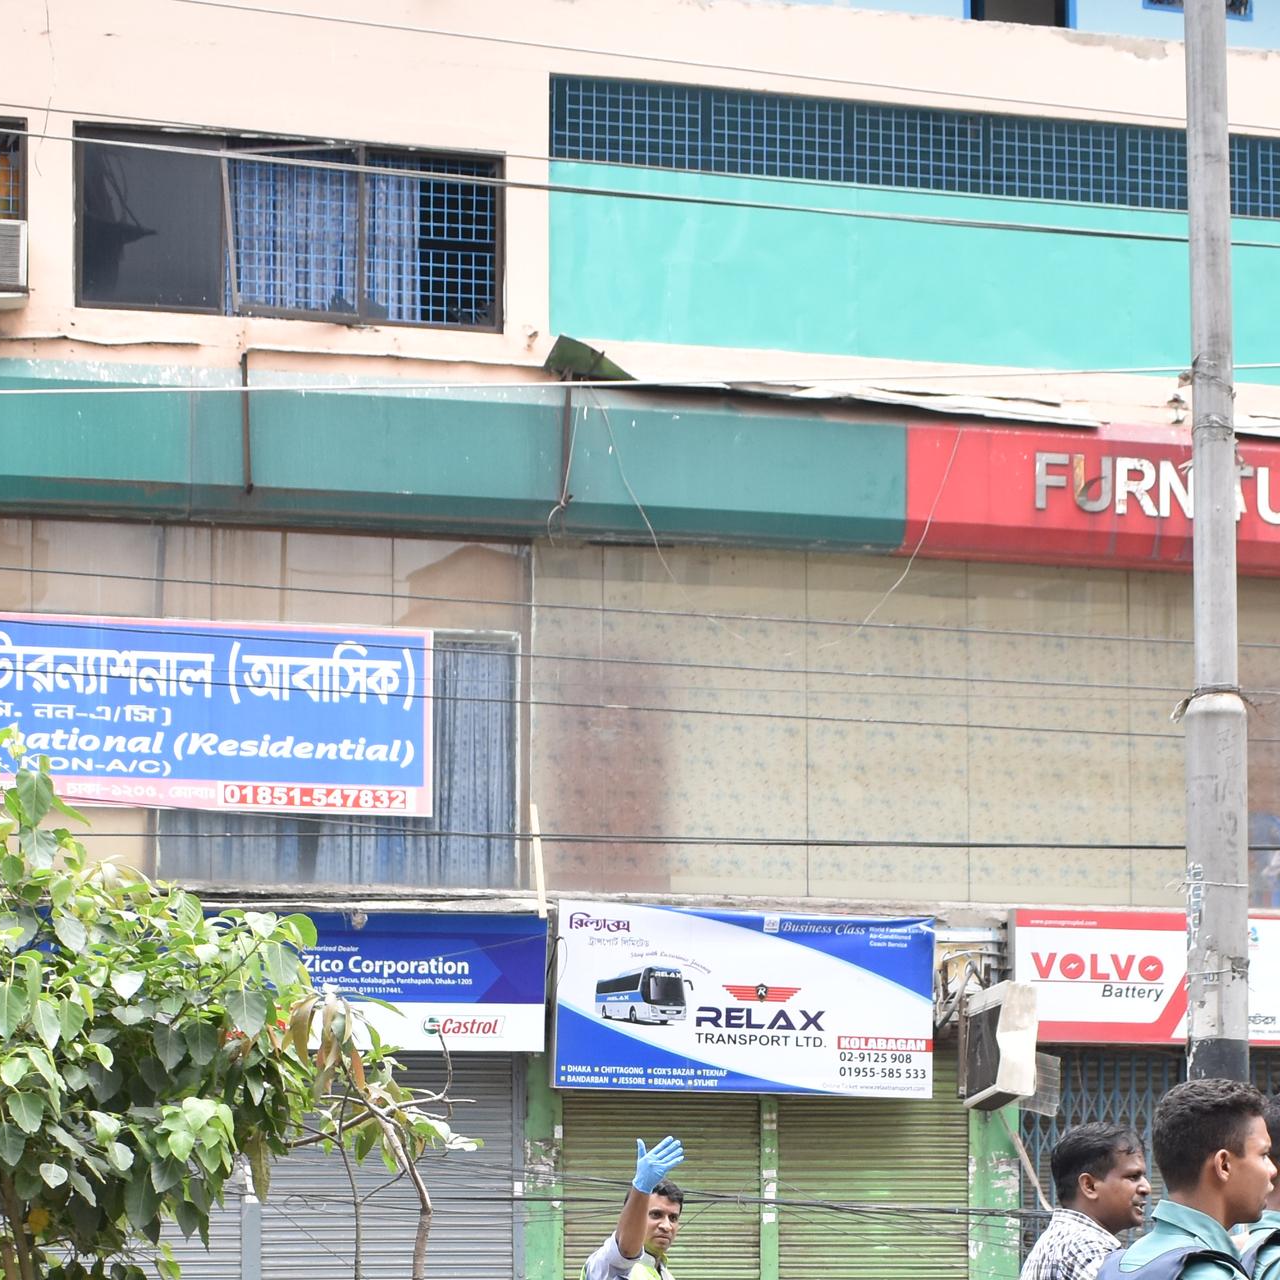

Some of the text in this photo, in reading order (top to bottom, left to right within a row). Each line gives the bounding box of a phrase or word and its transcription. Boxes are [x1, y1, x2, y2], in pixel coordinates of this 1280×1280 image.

[228, 640, 416, 712] (আবাসিক)
[173, 731, 415, 769] (Residential)
[21, 755, 172, 777] NON-A/C)
[224, 784, 407, 810] 01851-547832
[781, 921, 866, 936] Business Class
[301, 954, 469, 977] Zico Corporation
[1030, 951, 1165, 982] VOLVO
[1101, 984, 1164, 1002] Battery
[441, 1017, 498, 1035] Castrol
[695, 1006, 826, 1032] RELAX
[695, 1032, 827, 1048] TRANSPORT LTD.
[839, 1036, 927, 1051] KOLABAGAN
[839, 1051, 912, 1064] 02-9125 908
[567, 1065, 591, 1073] DHAKA
[601, 1066, 644, 1075] CHITTAGONG
[672, 1068, 695, 1076] BAZAR
[702, 1069, 727, 1077] TEKNAF
[839, 1066, 927, 1079] 01955-585 533
[567, 1075, 718, 1087] BANDARBAN JESSORE BENAPOL SYLHET
